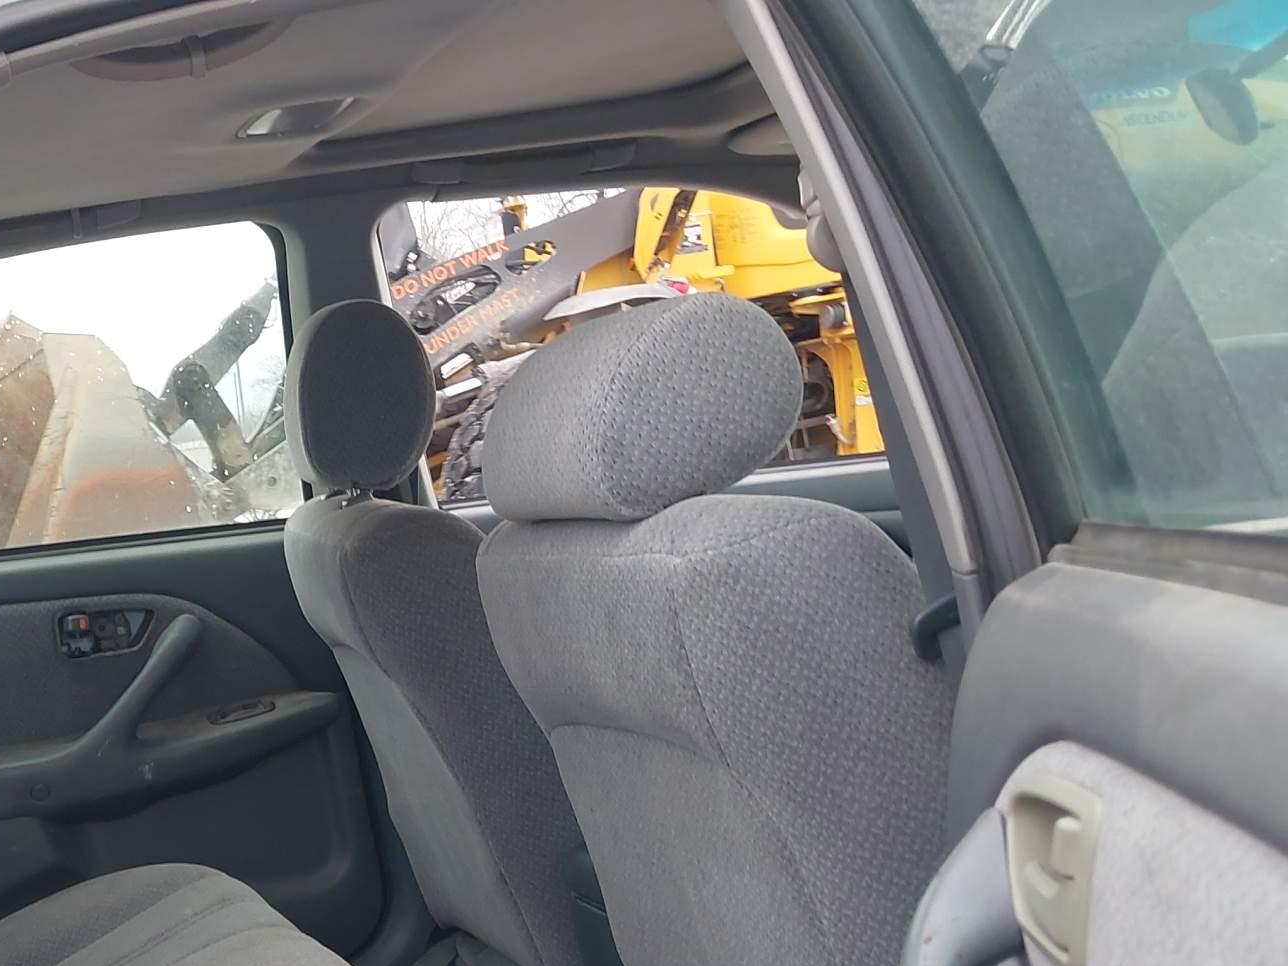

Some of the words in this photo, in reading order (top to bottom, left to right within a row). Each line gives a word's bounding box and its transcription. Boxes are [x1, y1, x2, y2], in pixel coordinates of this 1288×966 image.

[392, 279, 418, 300] DO
[420, 261, 457, 287] NOT
[459, 240, 509, 268] WALK
[424, 315, 478, 353] UNDER
